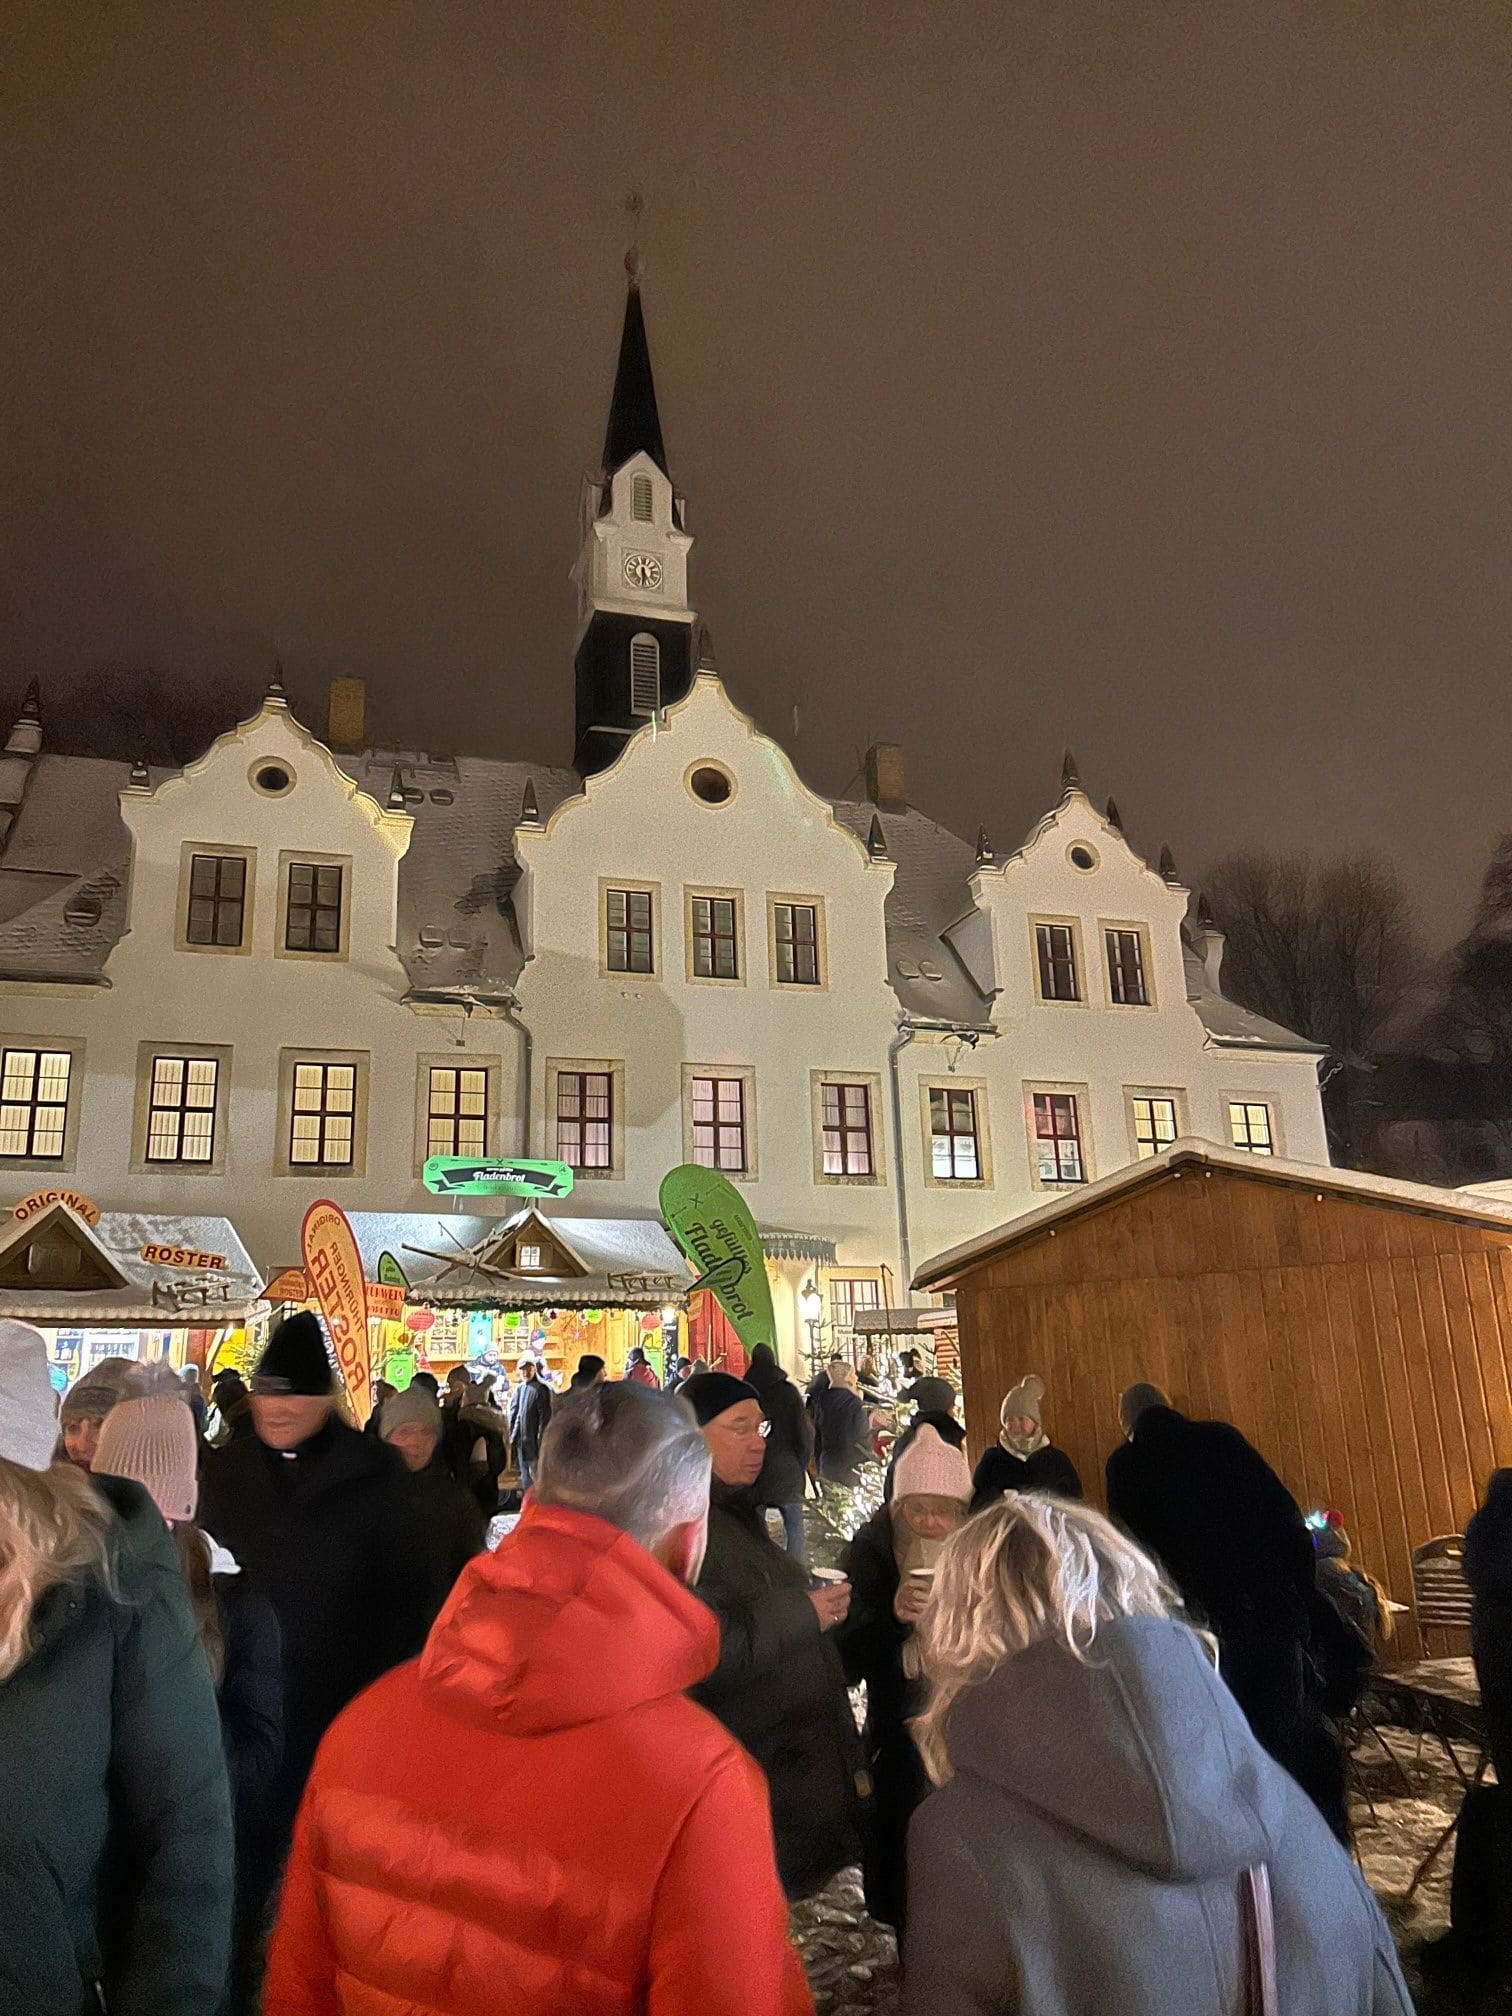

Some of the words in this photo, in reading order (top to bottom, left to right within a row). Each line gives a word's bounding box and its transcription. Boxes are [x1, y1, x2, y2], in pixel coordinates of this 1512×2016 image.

[472, 1171, 526, 1182] Fladenbrot
[15, 1192, 97, 1223] ORIGINAL
[144, 1245, 222, 1269] ROSTER
[685, 1222, 754, 1320] Fladbrot
